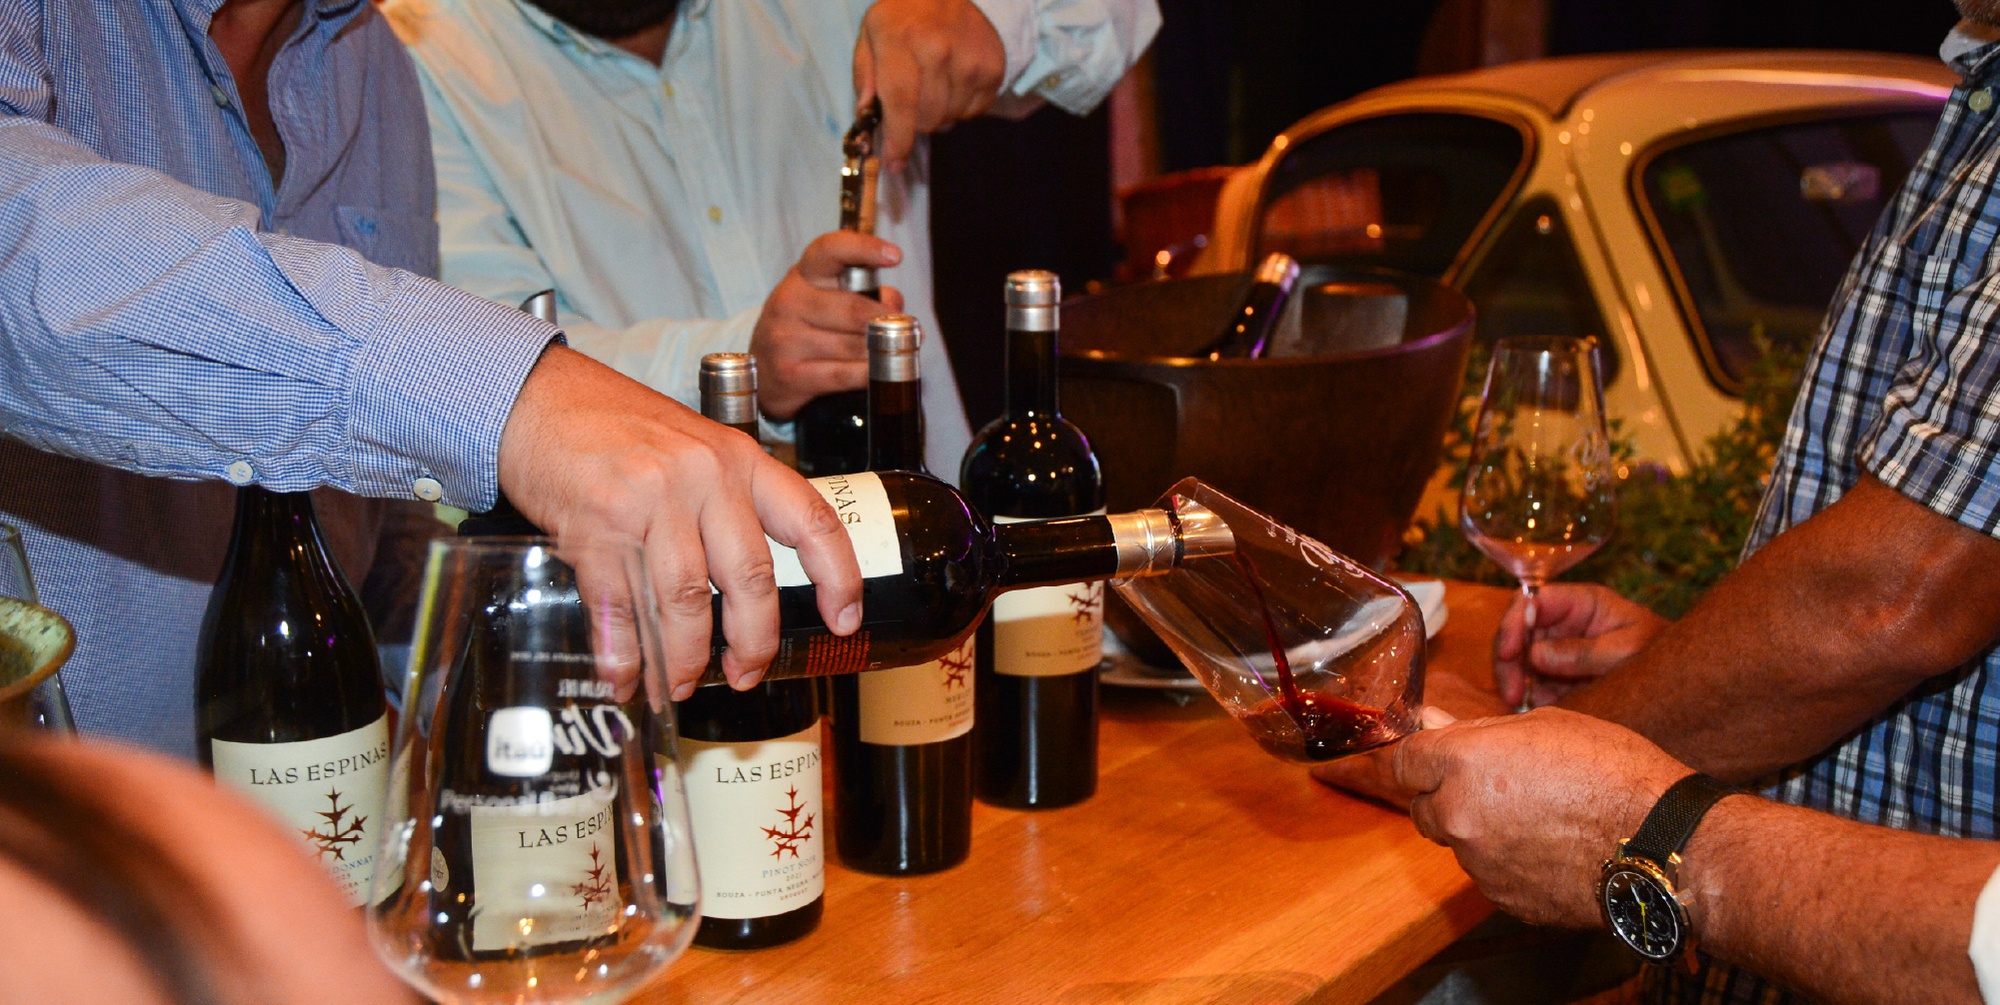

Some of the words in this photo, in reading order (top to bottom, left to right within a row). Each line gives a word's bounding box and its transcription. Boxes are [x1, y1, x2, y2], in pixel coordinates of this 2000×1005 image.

[825, 475, 861, 525] PINAS
[250, 767, 299, 785] LAS
[306, 742, 388, 782] ESPINAS
[715, 765, 762, 784] LAS
[769, 747, 821, 780] ESPIN
[518, 825, 568, 849] LAS
[574, 801, 614, 839] ESPIN
[755, 887, 783, 898] PUNTA
[786, 879, 809, 892] NEGRA
[762, 863, 797, 879] PINOT
